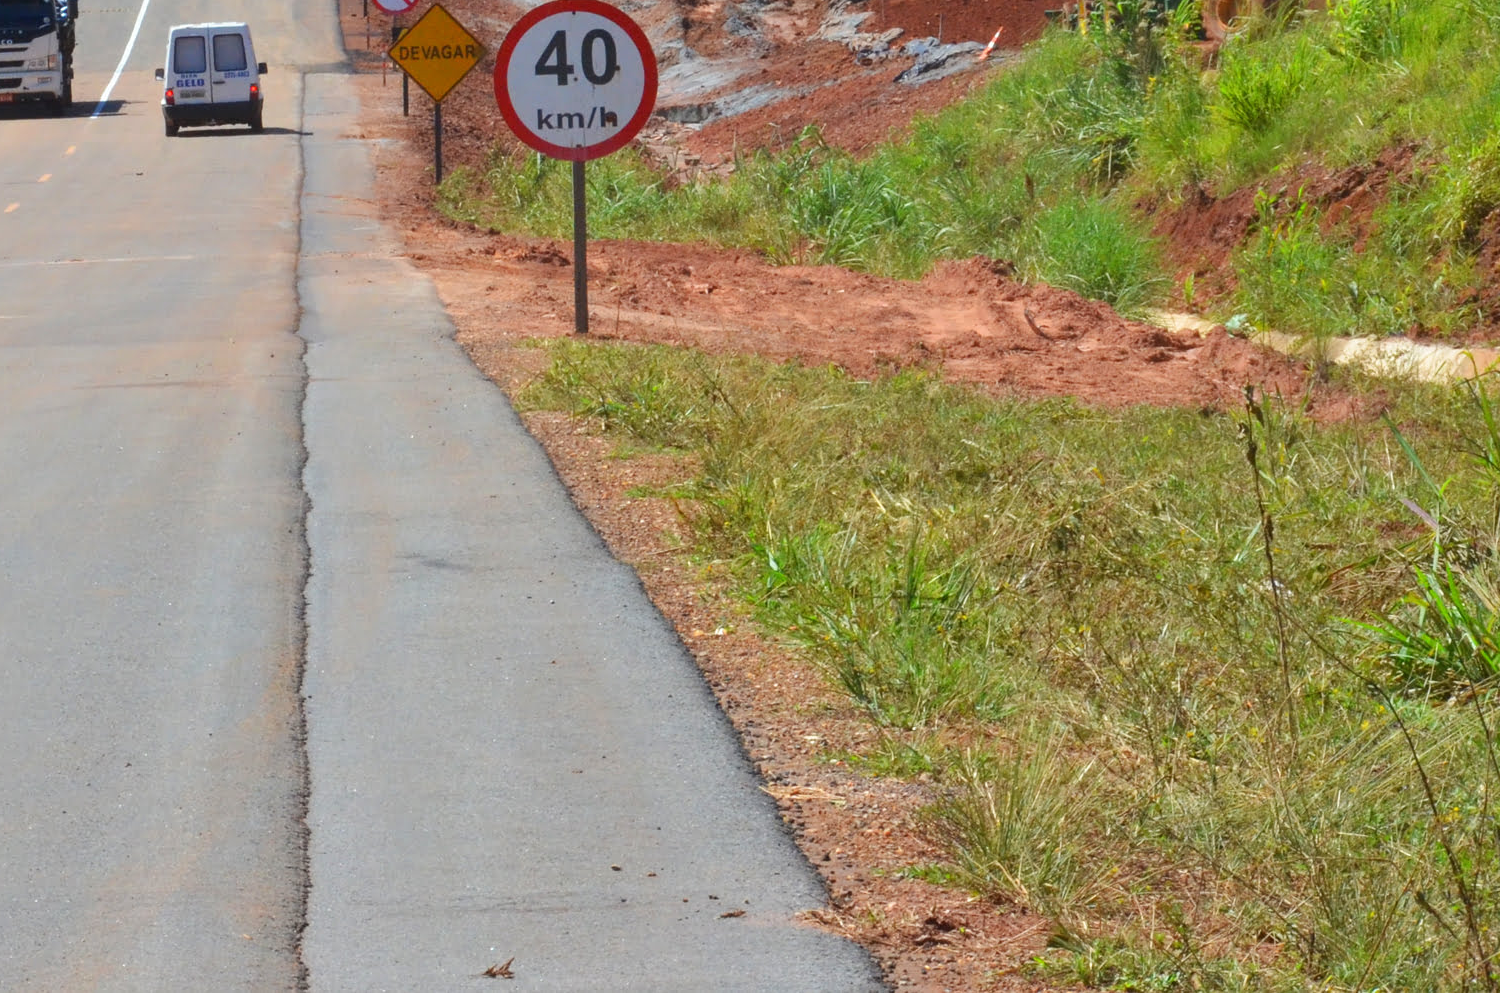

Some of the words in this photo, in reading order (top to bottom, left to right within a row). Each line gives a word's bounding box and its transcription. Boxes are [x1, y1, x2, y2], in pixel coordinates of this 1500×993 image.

[399, 44, 476, 61] DEVAGAR
[534, 28, 618, 87] 40
[176, 78, 205, 88] GELO
[537, 106, 618, 130] km/h
